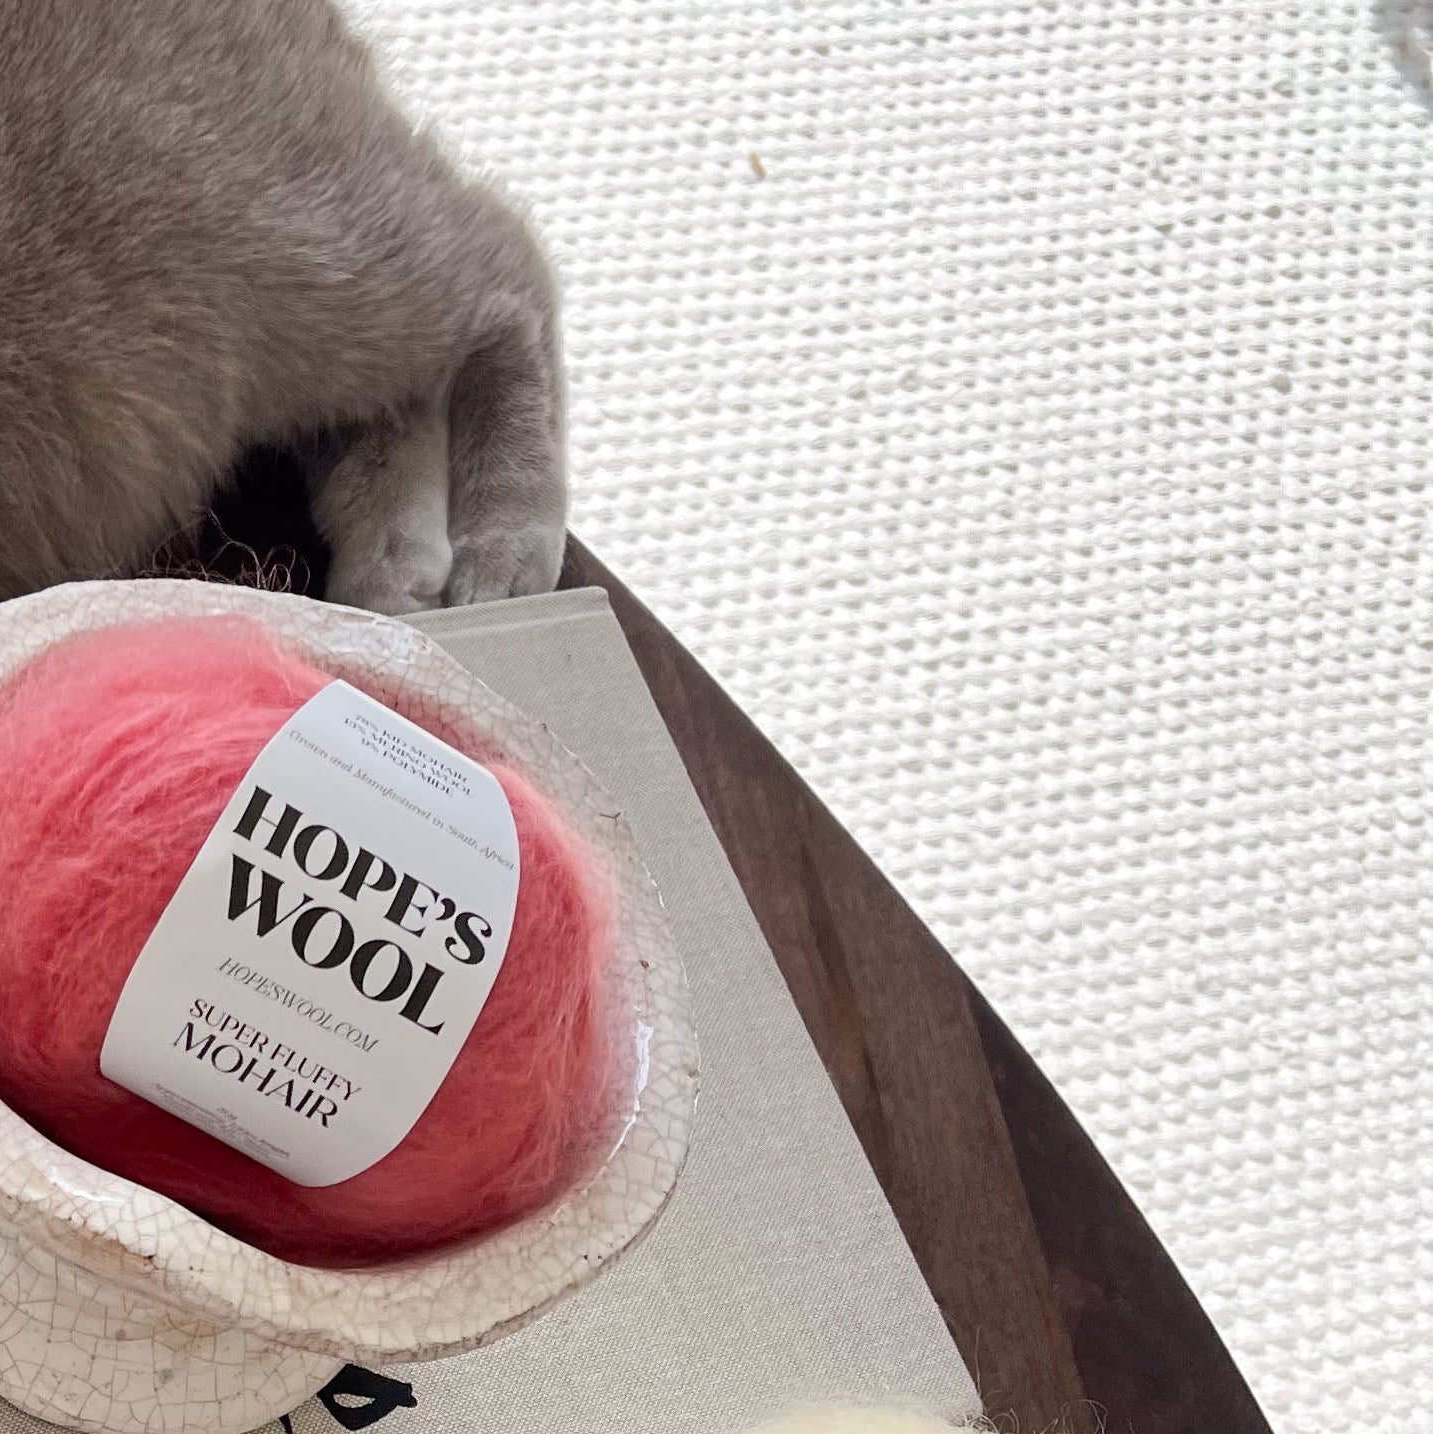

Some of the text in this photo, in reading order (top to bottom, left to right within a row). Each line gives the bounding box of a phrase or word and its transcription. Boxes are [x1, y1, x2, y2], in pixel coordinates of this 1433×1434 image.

[227, 853, 446, 1036] WOOL
[232, 785, 493, 966] HOPE'S
[173, 1021, 338, 1128] MOHAIR
[189, 998, 363, 1105] SUPER FLUFFY
